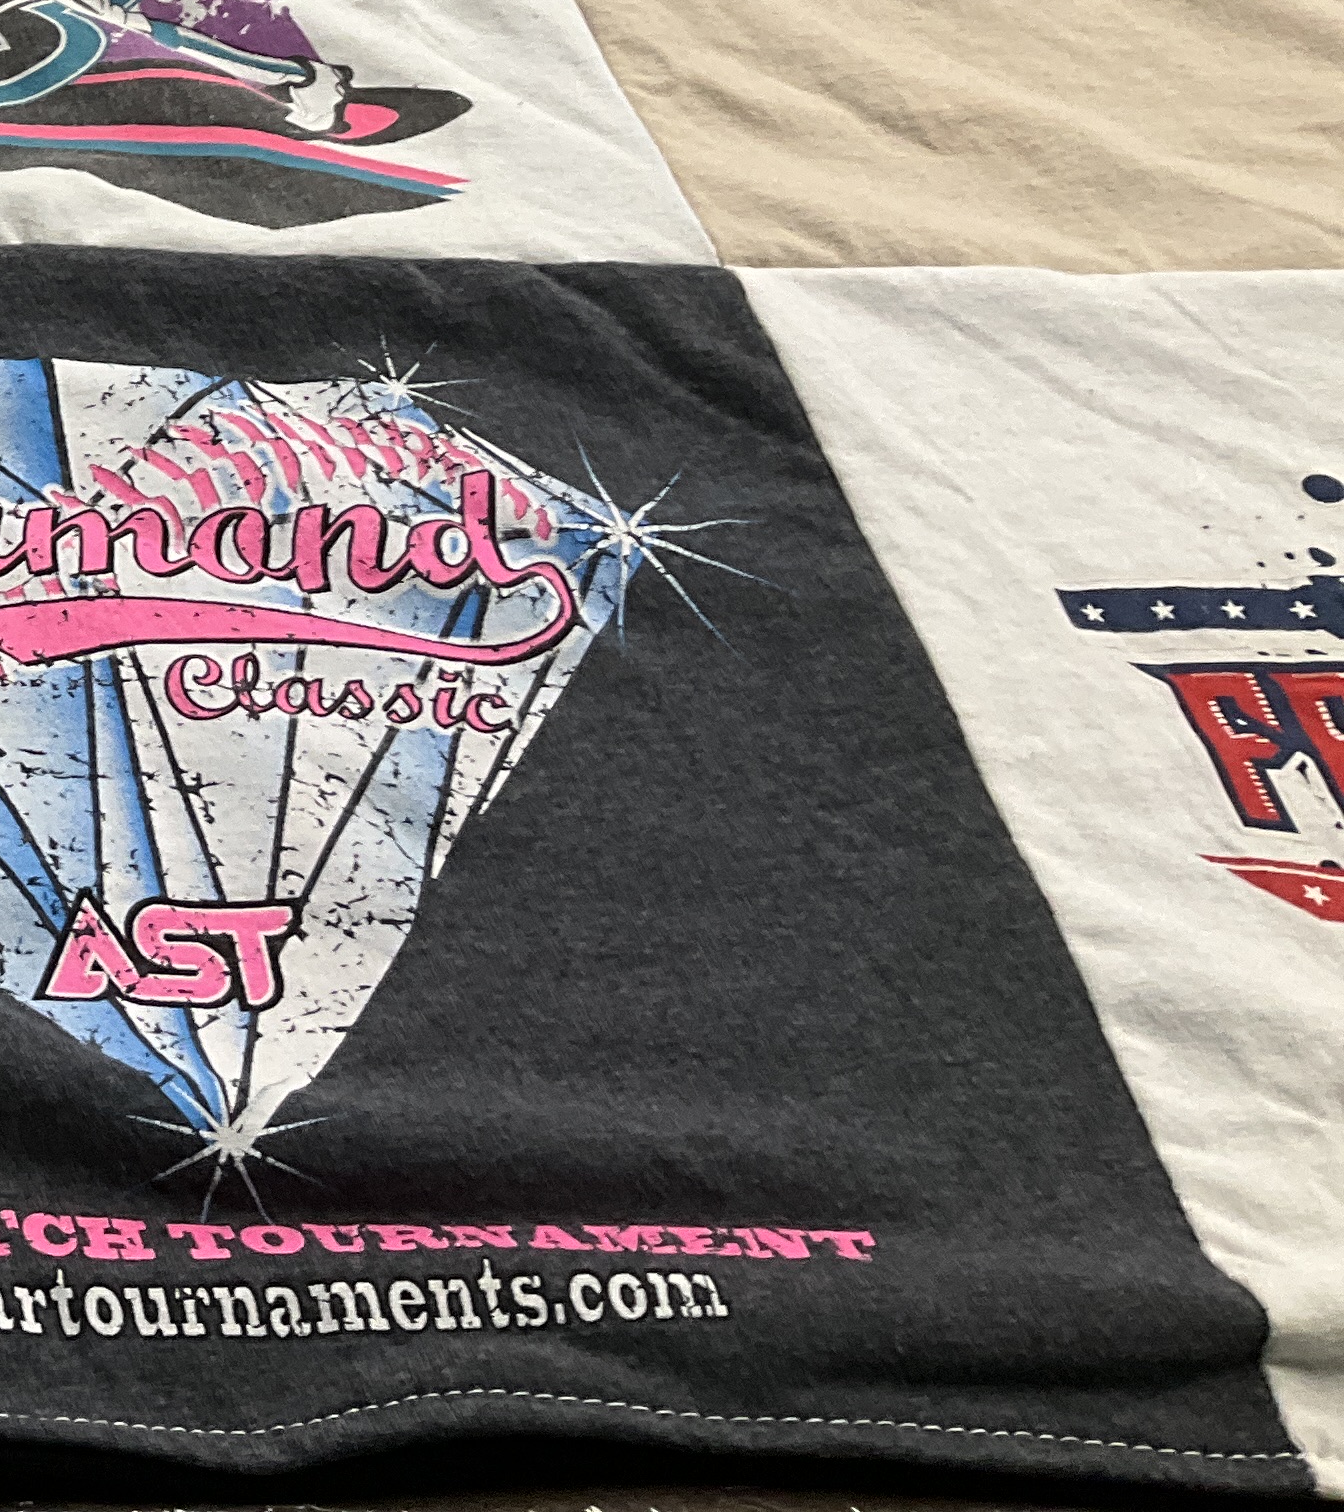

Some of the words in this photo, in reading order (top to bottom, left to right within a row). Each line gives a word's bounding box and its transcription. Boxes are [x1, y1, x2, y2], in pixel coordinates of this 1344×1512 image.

[160, 651, 520, 738] Classic
[34, 892, 304, 1009] AST
[167, 1220, 879, 1262] TOURNAMENT
